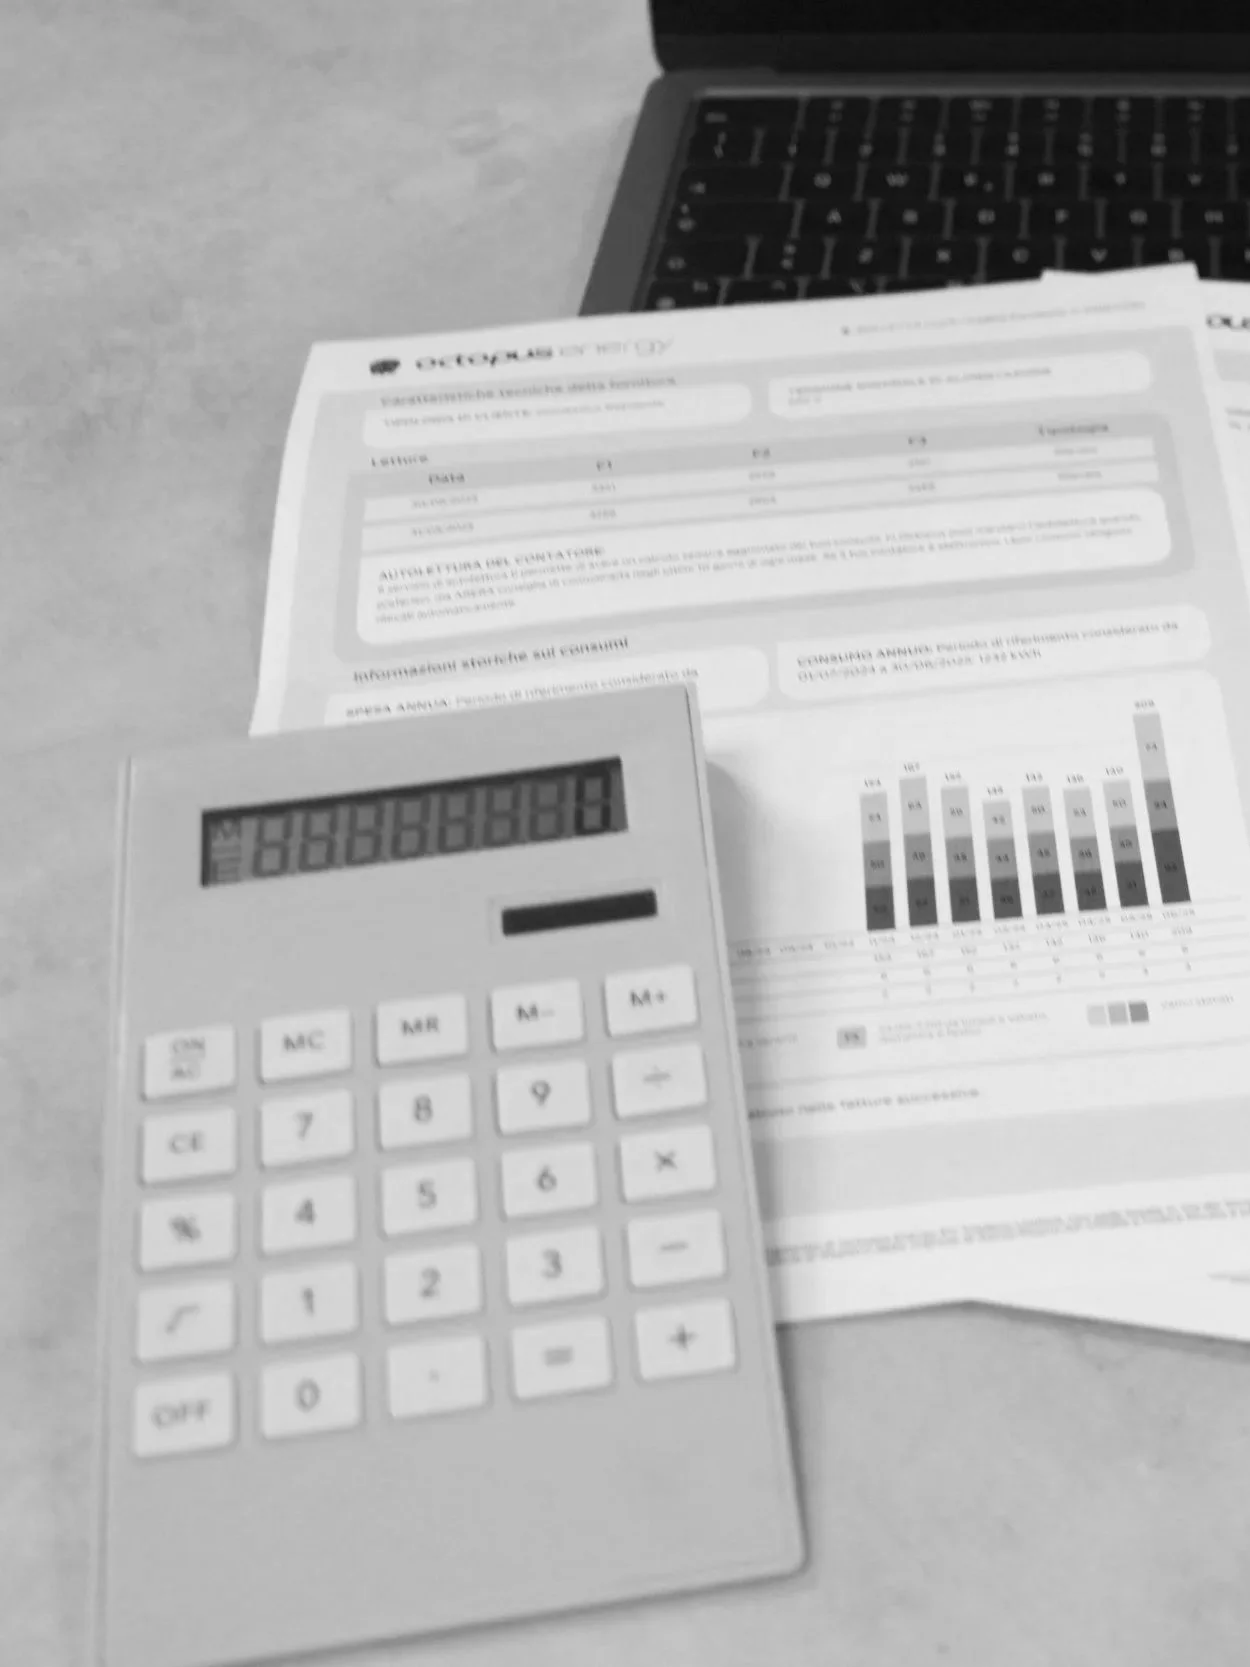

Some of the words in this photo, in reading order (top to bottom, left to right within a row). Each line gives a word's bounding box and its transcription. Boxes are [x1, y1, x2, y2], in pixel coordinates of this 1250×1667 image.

[415, 345, 553, 371] octopus
[401, 1013, 440, 1036] MR
[283, 1029, 326, 1053] MC
[413, 1093, 433, 1125] 8
[530, 1079, 552, 1108] 9
[297, 1110, 315, 1142] 7
[416, 1178, 438, 1210] 5
[536, 1165, 558, 1193] 6
[293, 1197, 317, 1227] 4
[541, 1247, 563, 1281] 3
[418, 1265, 442, 1298] 2
[302, 1286, 316, 1317] 1
[294, 1376, 322, 1414] 0
